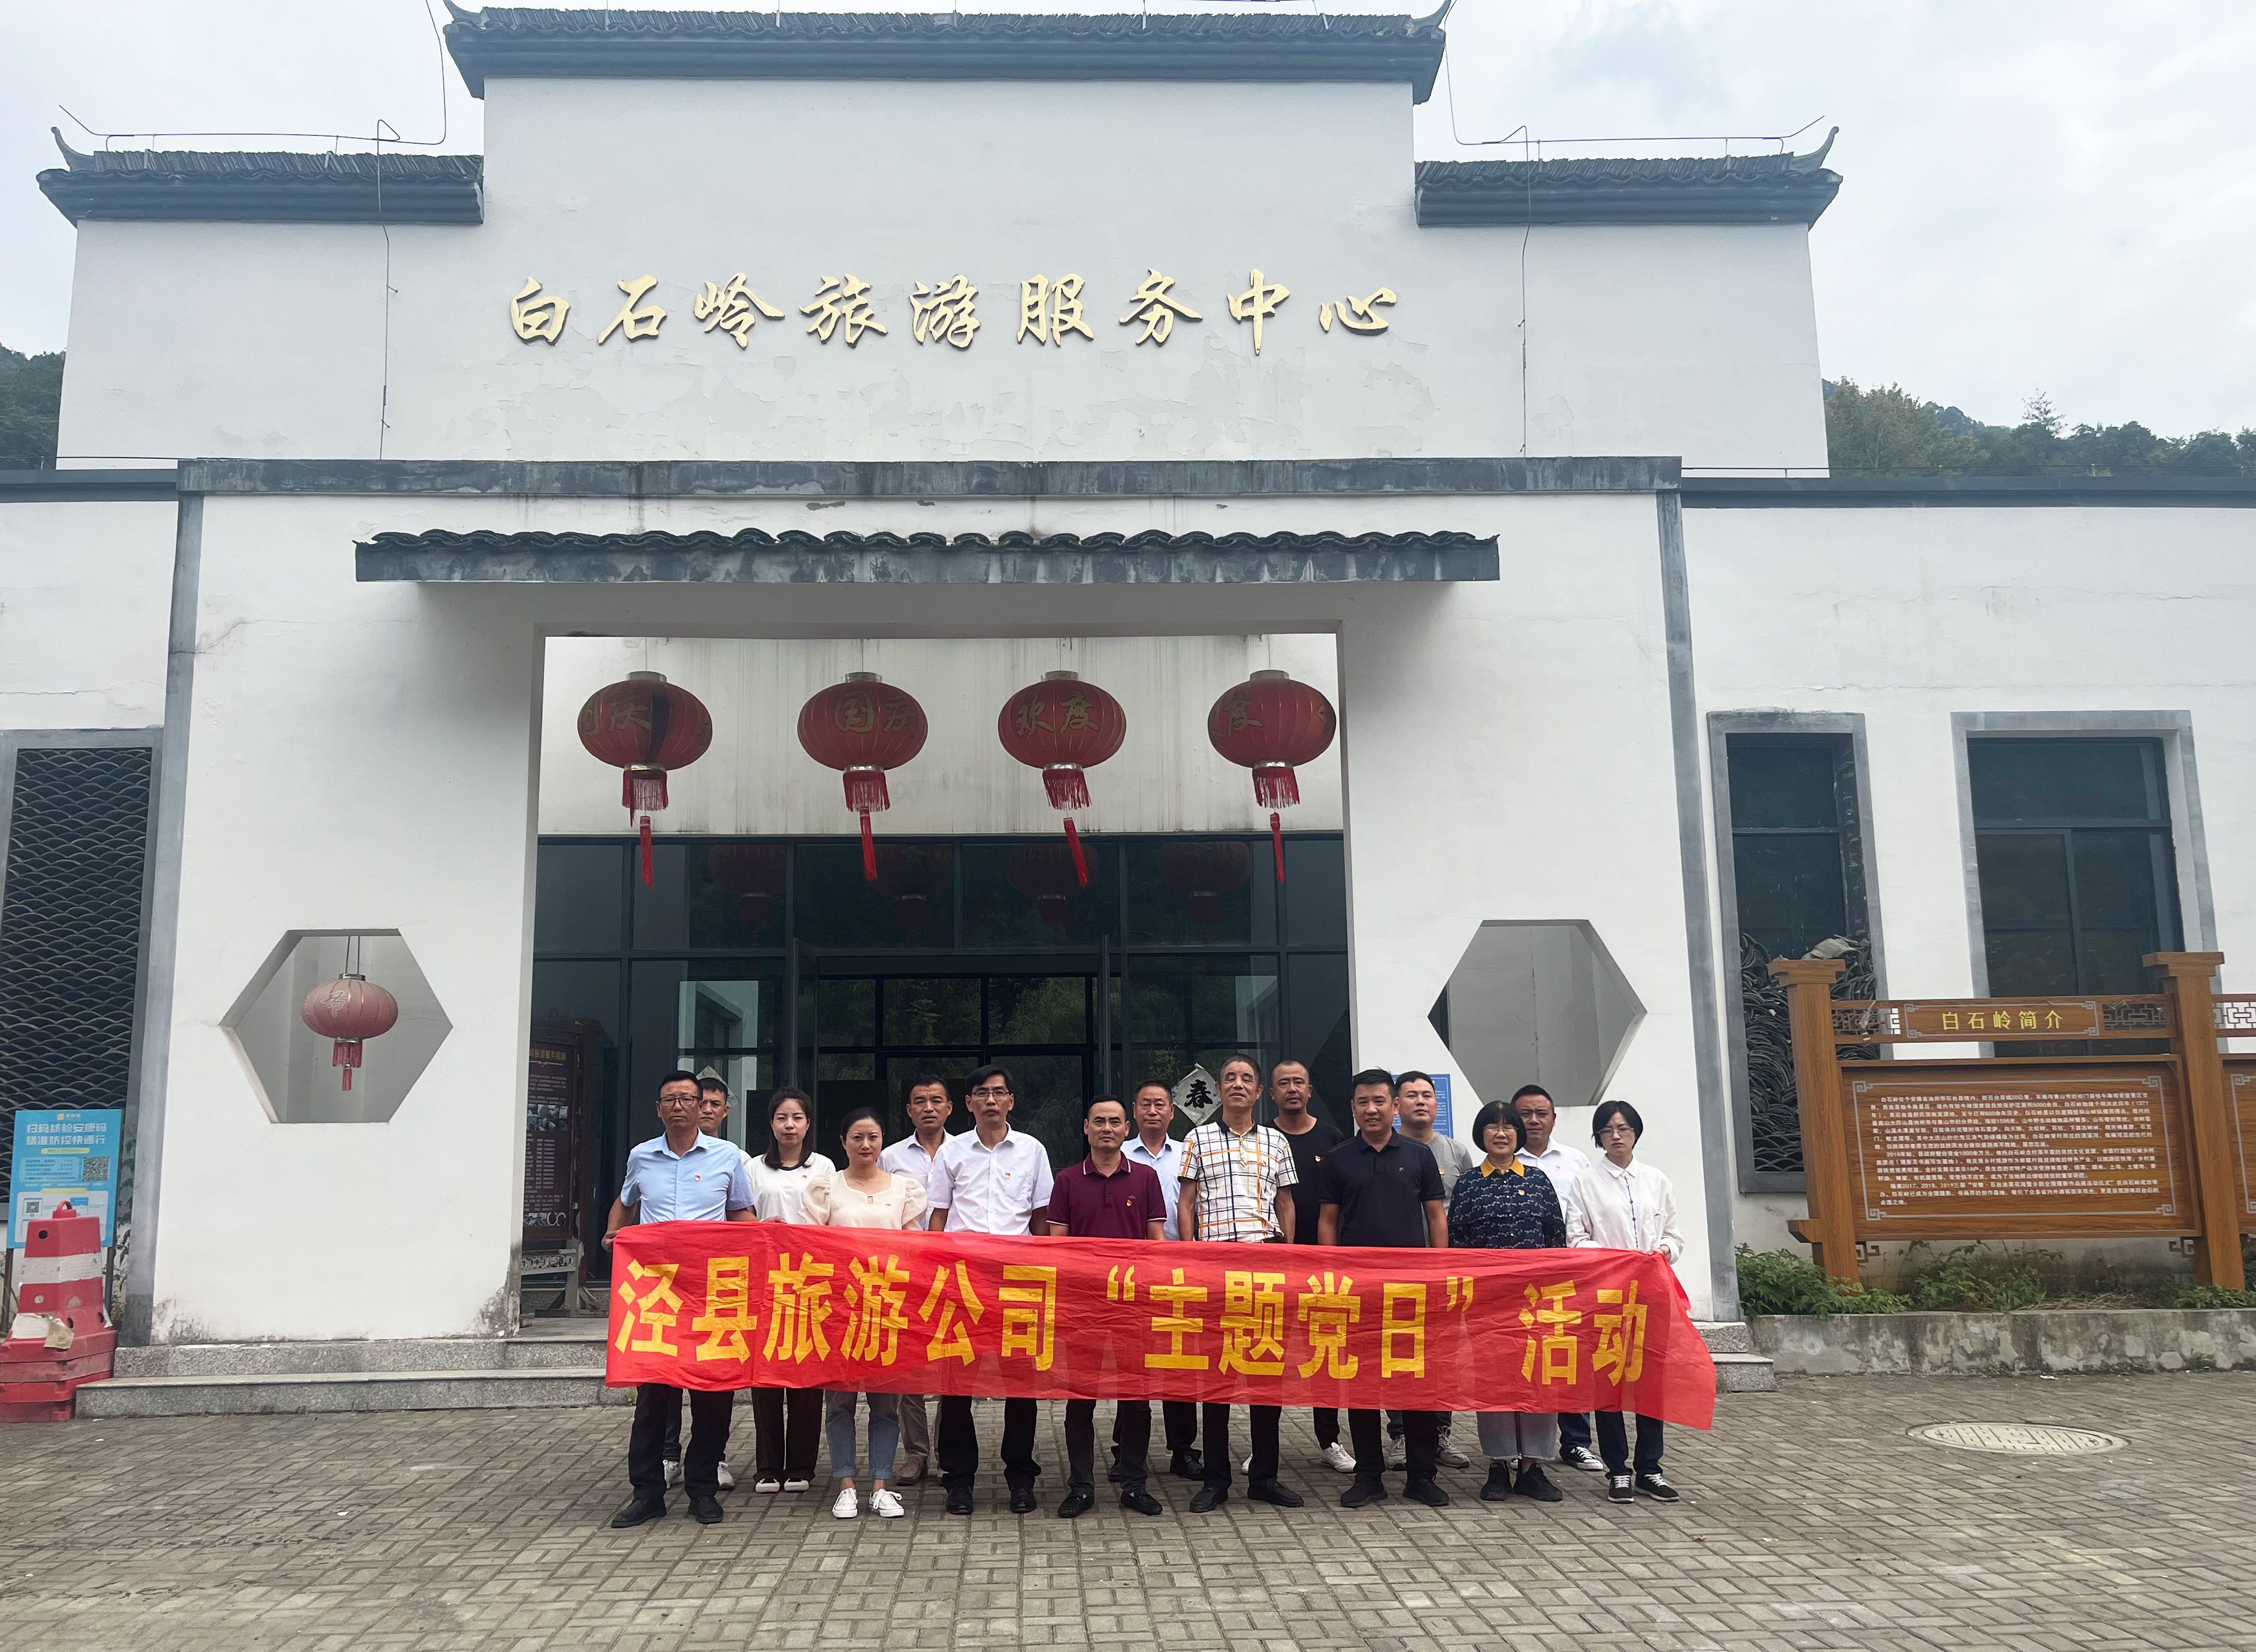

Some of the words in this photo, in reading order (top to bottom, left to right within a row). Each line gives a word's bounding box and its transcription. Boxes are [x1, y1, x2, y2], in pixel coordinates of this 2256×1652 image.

[510, 268, 1398, 355] 白石岭旅游服务中心
[1015, 691, 1100, 737] 欢度
[1942, 1010, 2063, 1030] 白石岭简介
[1184, 1079, 1213, 1108] 春
[26, 1123, 107, 1133] 扫码核验安康码
[614, 1252, 1058, 1372] 泾县旅游公司
[1106, 1267, 1474, 1381] “主题党日”
[1518, 1281, 1647, 1385] 活动
